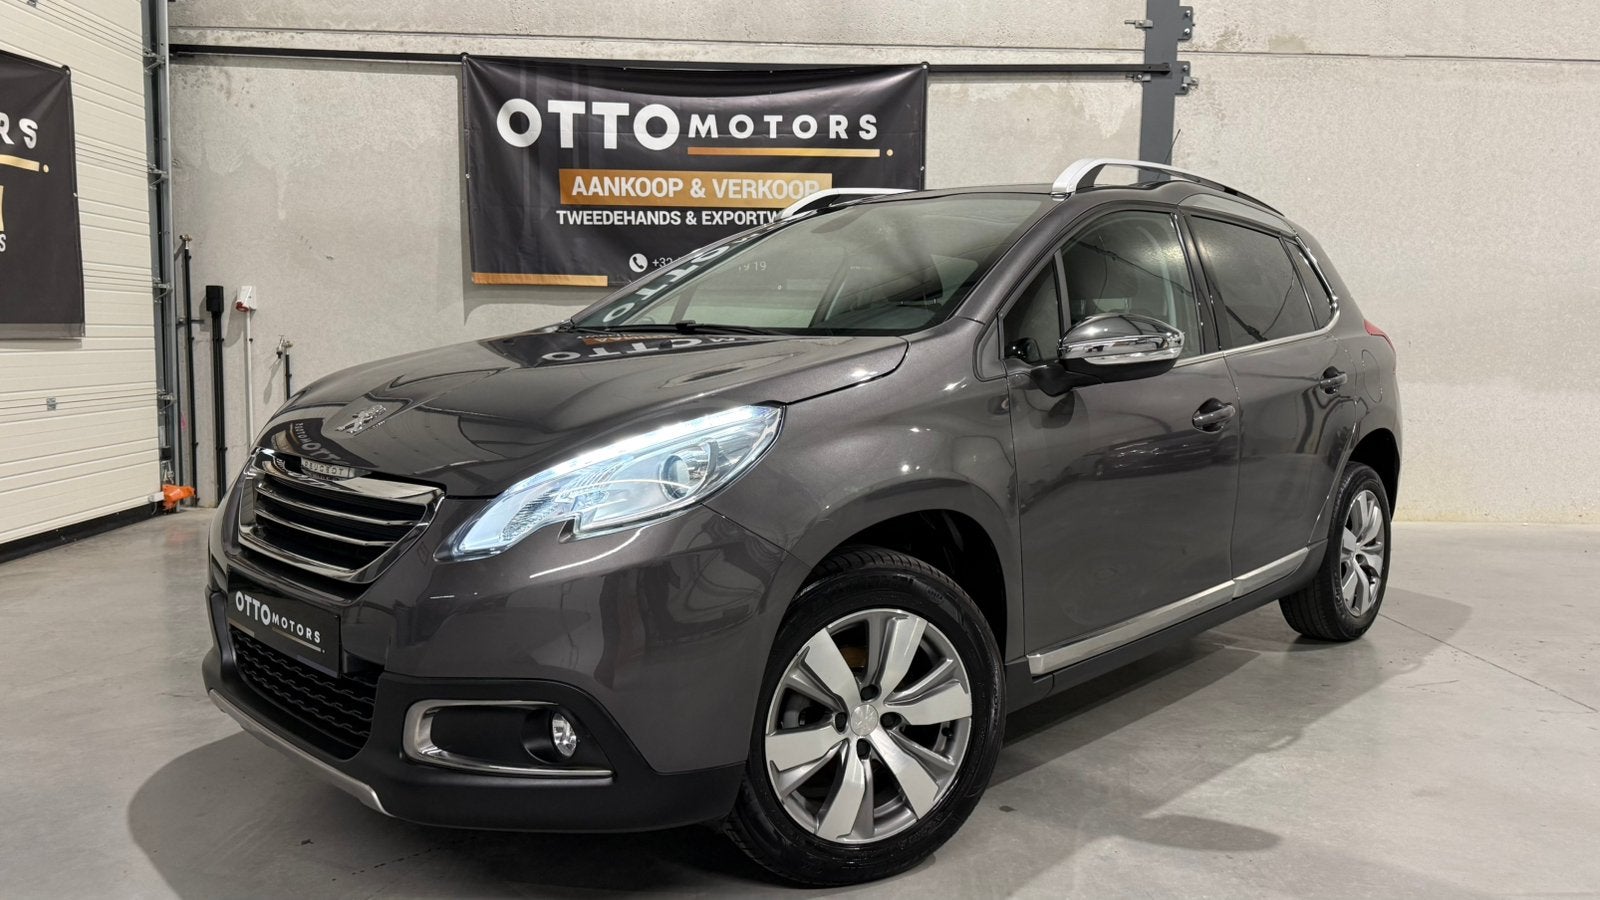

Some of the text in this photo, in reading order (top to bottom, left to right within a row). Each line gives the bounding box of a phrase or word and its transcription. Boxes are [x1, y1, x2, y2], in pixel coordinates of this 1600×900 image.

[496, 98, 877, 150] OTTO MOTORS
[572, 176, 820, 199] AANKOOP & VERKOOP
[556, 210, 681, 225] TWEEDEHANDS
[685, 211, 697, 225] &
[235, 590, 321, 643] OTTO MOTORS
